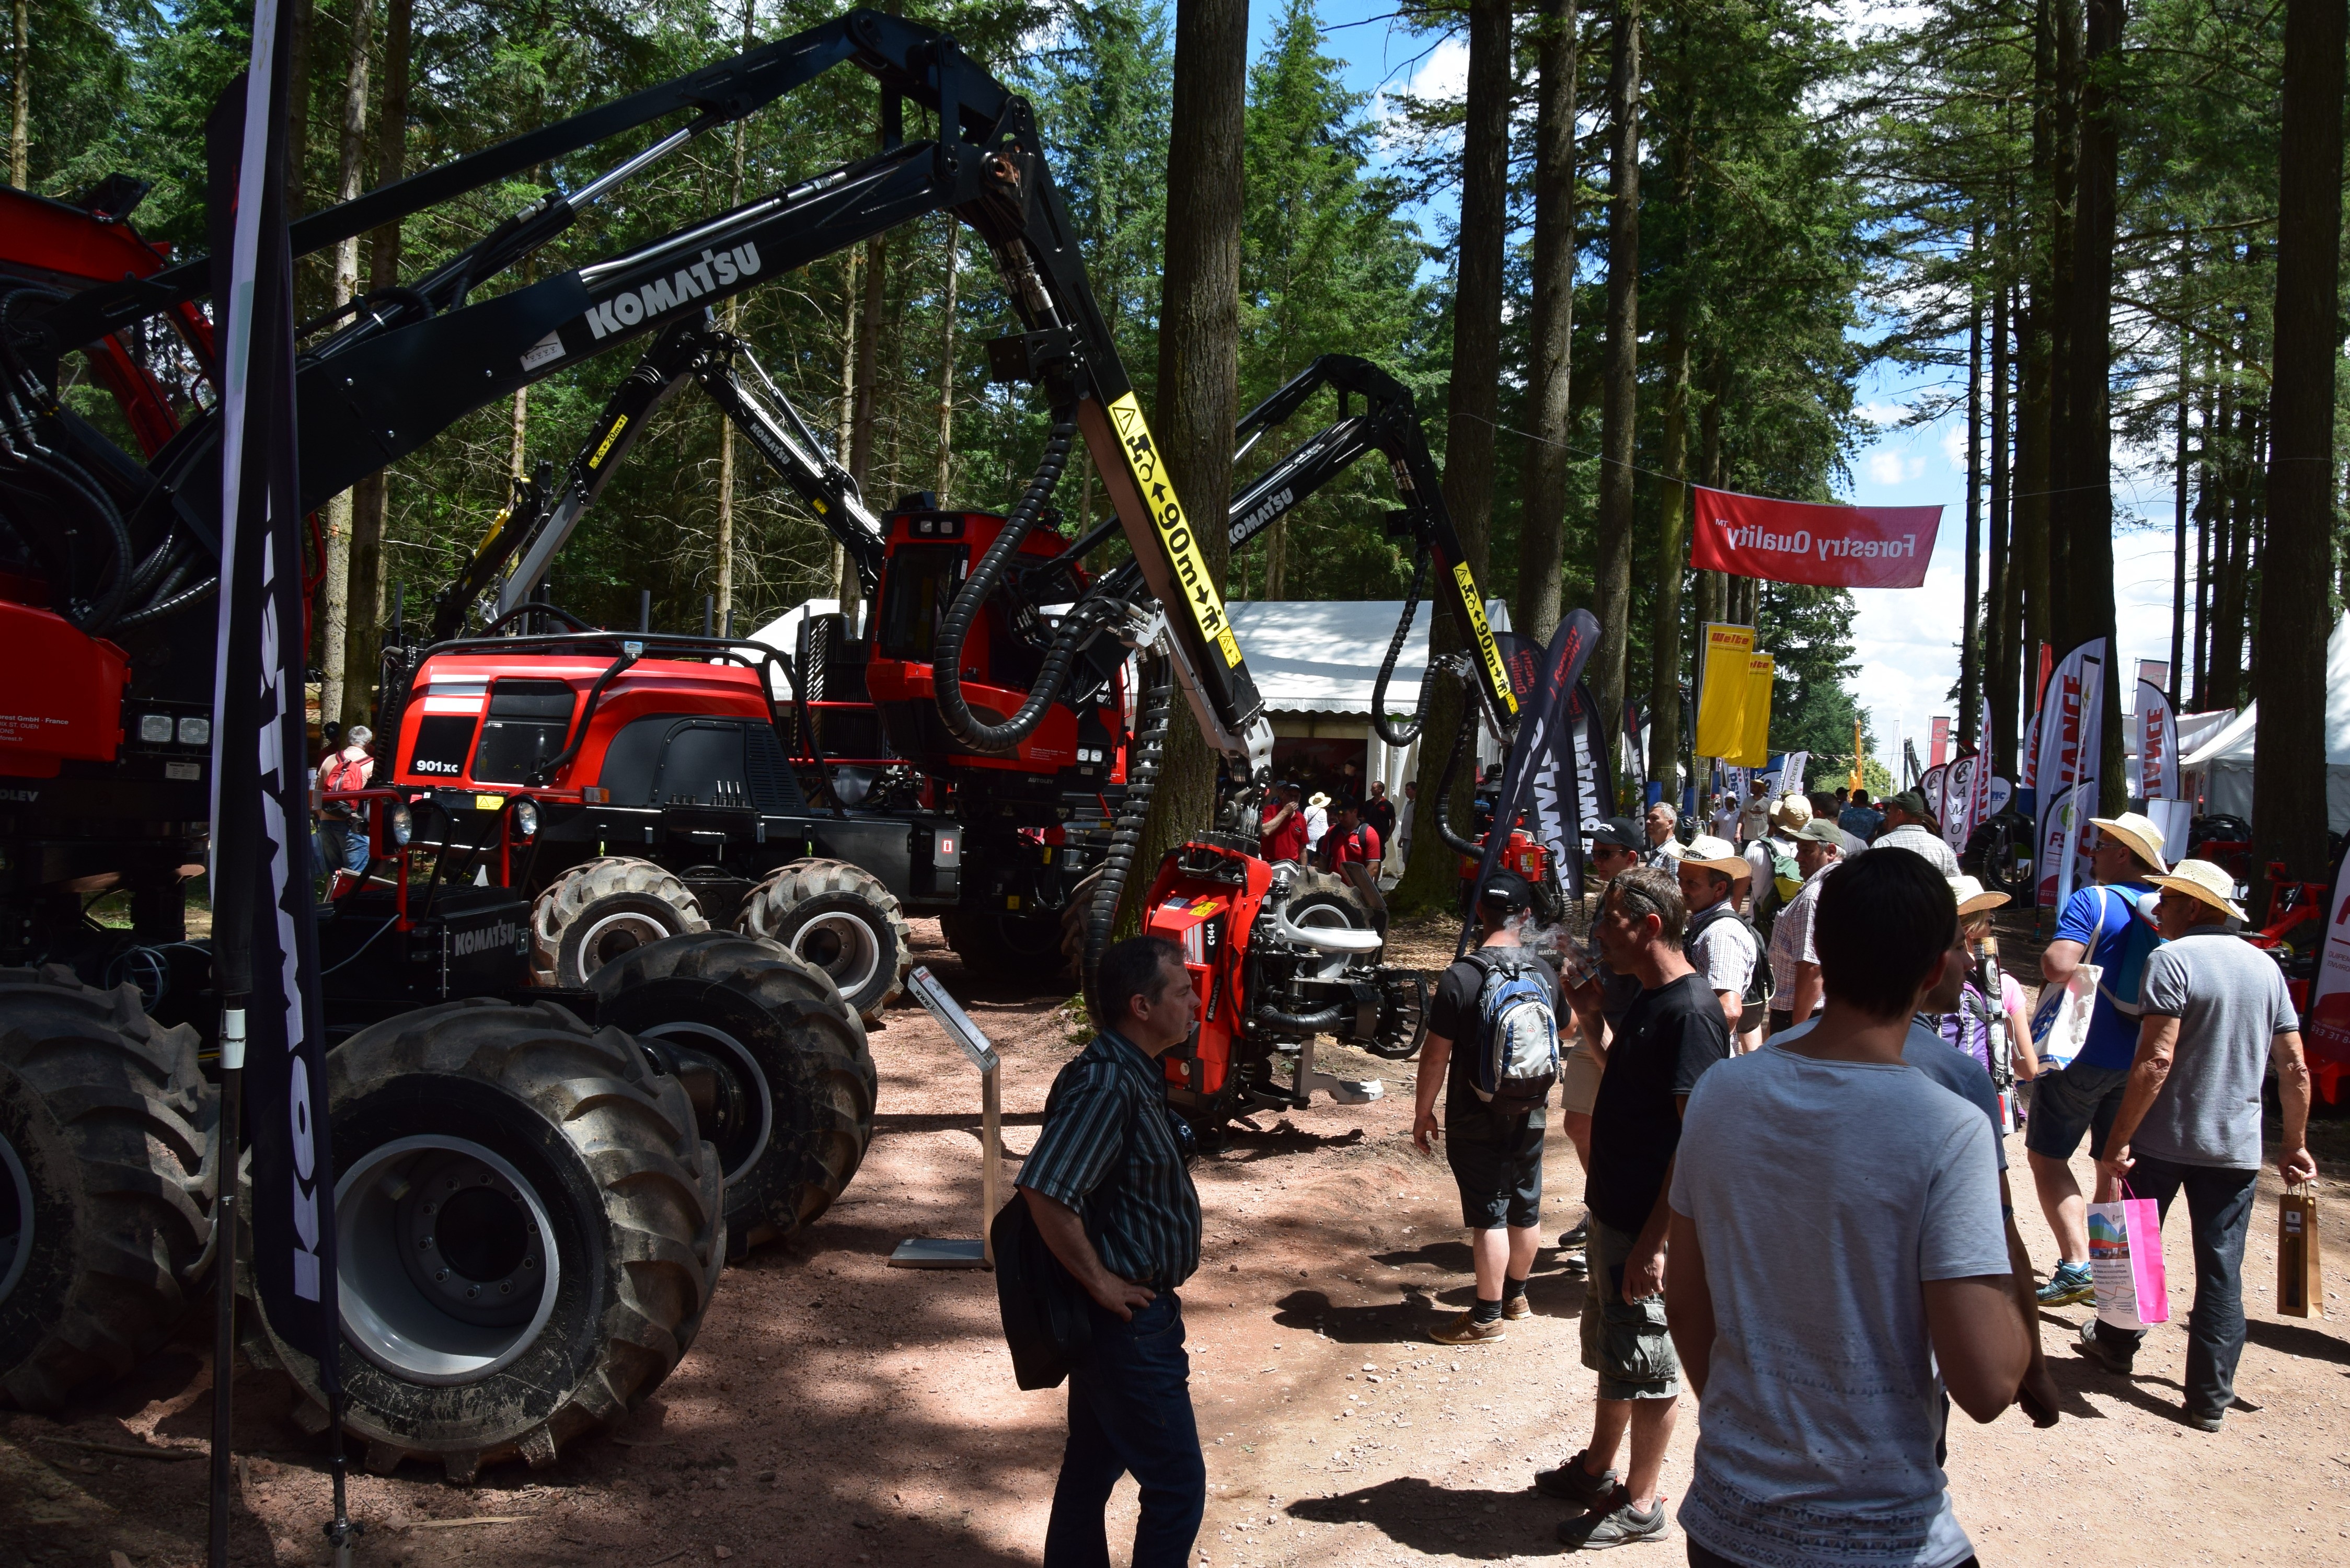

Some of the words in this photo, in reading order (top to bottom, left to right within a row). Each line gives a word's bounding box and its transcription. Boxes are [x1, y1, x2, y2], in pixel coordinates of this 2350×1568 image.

[585, 241, 761, 339] KOMATSU
[606, 426, 621, 445] 20m
[750, 422, 791, 465] KOMATSU
[1229, 487, 1294, 546] KOMATSU
[1158, 502, 1197, 588] 90m
[1475, 620, 1496, 670] 90m
[1712, 632, 1749, 644] Welte
[1790, 757, 1800, 781] DEERE
[455, 919, 516, 956] KOMATSU
[1207, 977, 1222, 1019] KOMATSU
